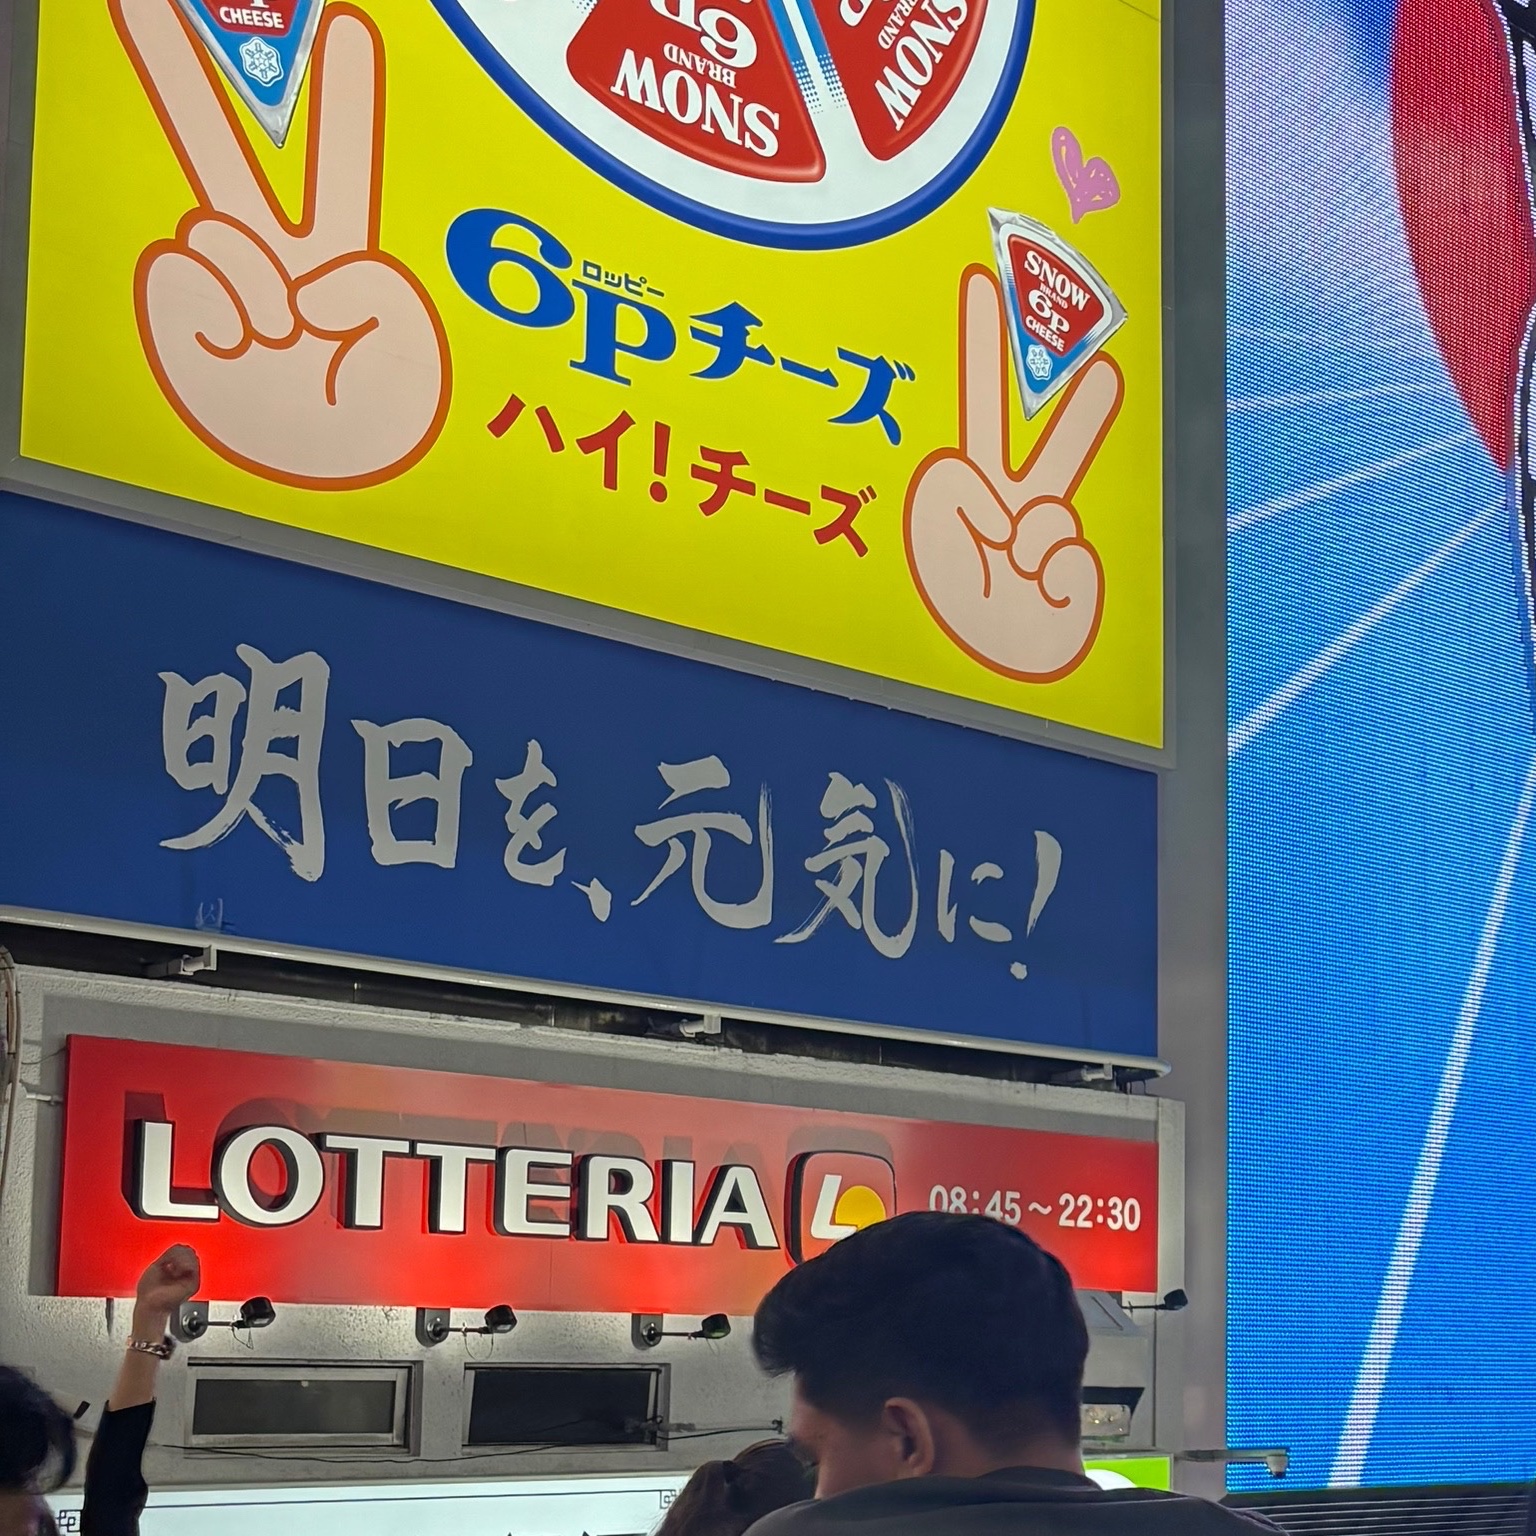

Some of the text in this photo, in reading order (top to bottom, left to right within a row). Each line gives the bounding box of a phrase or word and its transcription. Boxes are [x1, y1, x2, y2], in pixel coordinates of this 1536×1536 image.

[219, 6, 285, 29] CHEESE
[663, 42, 737, 89] BRAND
[874, 0, 969, 132] SNOW
[609, 48, 780, 158] SNOW
[580, 258, 666, 298] ロッピー
[1024, 250, 1091, 312] SNOW
[1039, 281, 1069, 310] BRAND
[1025, 314, 1066, 352] CHEESE
[486, 391, 878, 558] ハイ!チーズ
[135, 1120, 780, 1250] LOTTERIA
